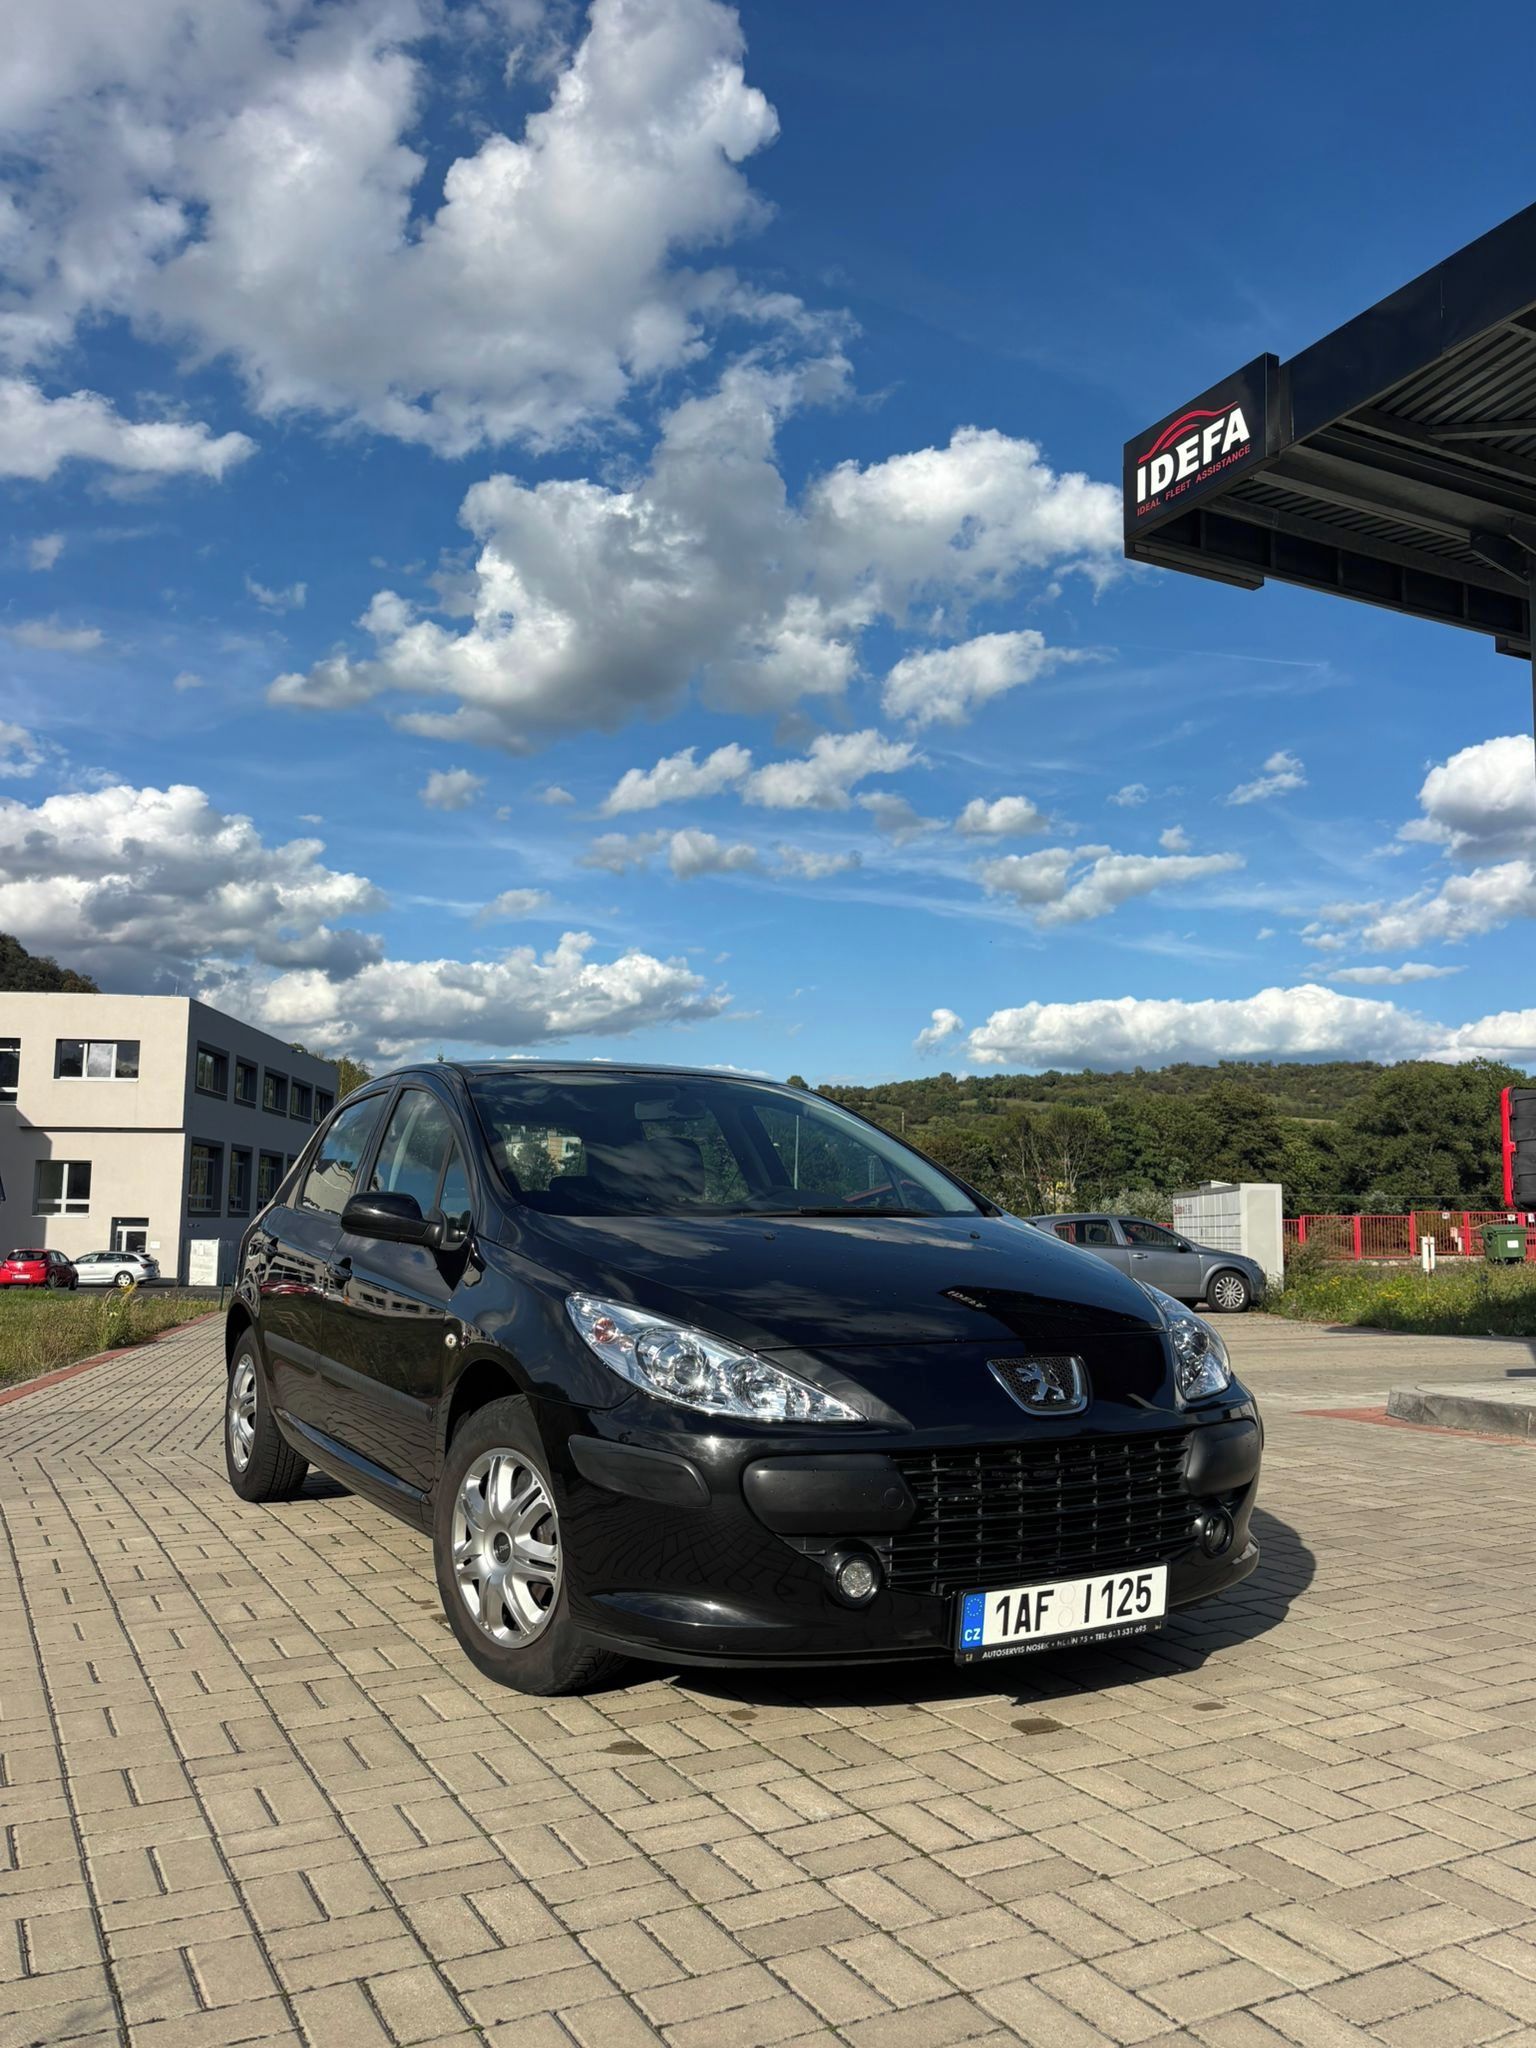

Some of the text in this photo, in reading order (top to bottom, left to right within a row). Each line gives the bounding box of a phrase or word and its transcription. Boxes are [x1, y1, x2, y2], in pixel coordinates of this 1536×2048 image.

[1137, 407, 1250, 503] IDEFA
[1137, 443, 1251, 517] IDEAL FLEET ASSISTANCE
[964, 1628, 980, 1642] CZ
[996, 1589, 1054, 1636] 1AF
[982, 1645, 1025, 1659] AUTOSERVIS
